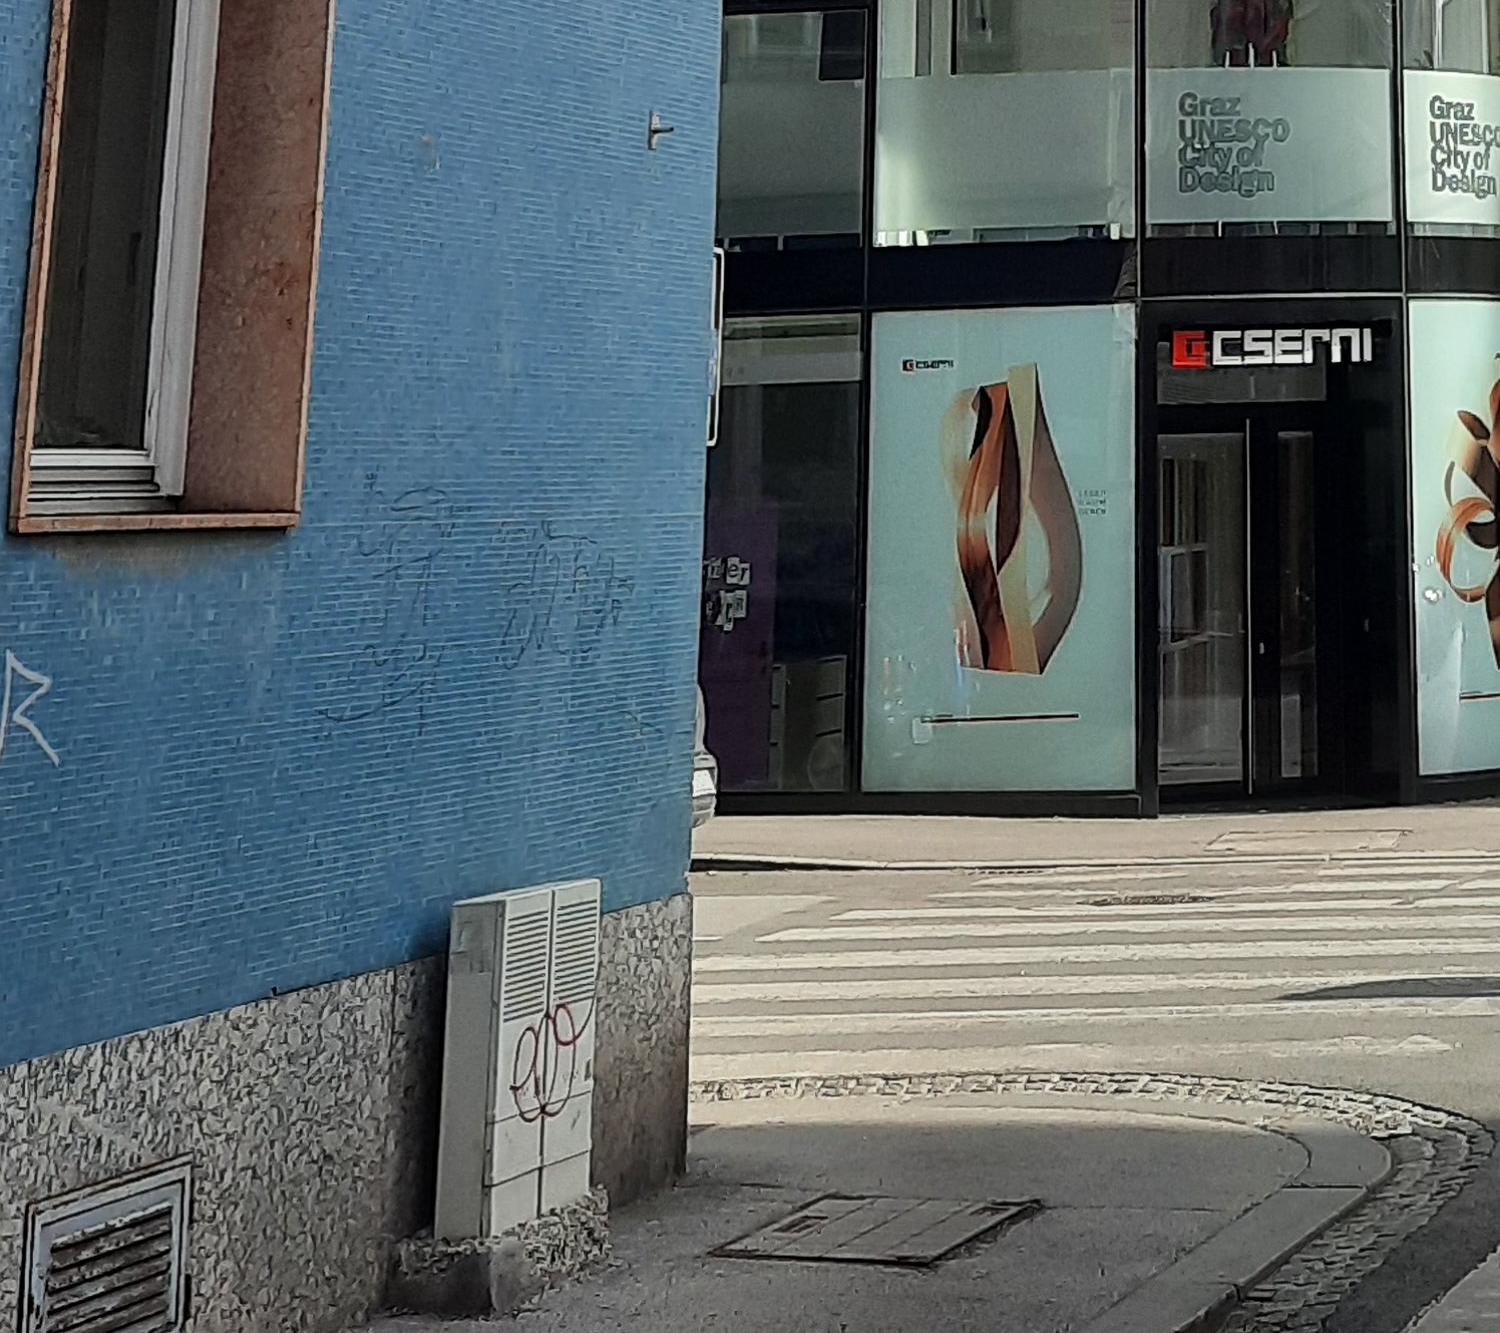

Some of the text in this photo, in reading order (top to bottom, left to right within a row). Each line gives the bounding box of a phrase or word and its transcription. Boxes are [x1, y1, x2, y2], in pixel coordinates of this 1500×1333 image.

[1179, 92, 1241, 116] Graz
[1430, 95, 1475, 121] Graz
[1179, 118, 1290, 143] UNESCO
[1179, 138, 1265, 173] City of
[1431, 144, 1490, 174] City of
[1179, 165, 1275, 198] Design
[1432, 168, 1497, 200] Design
